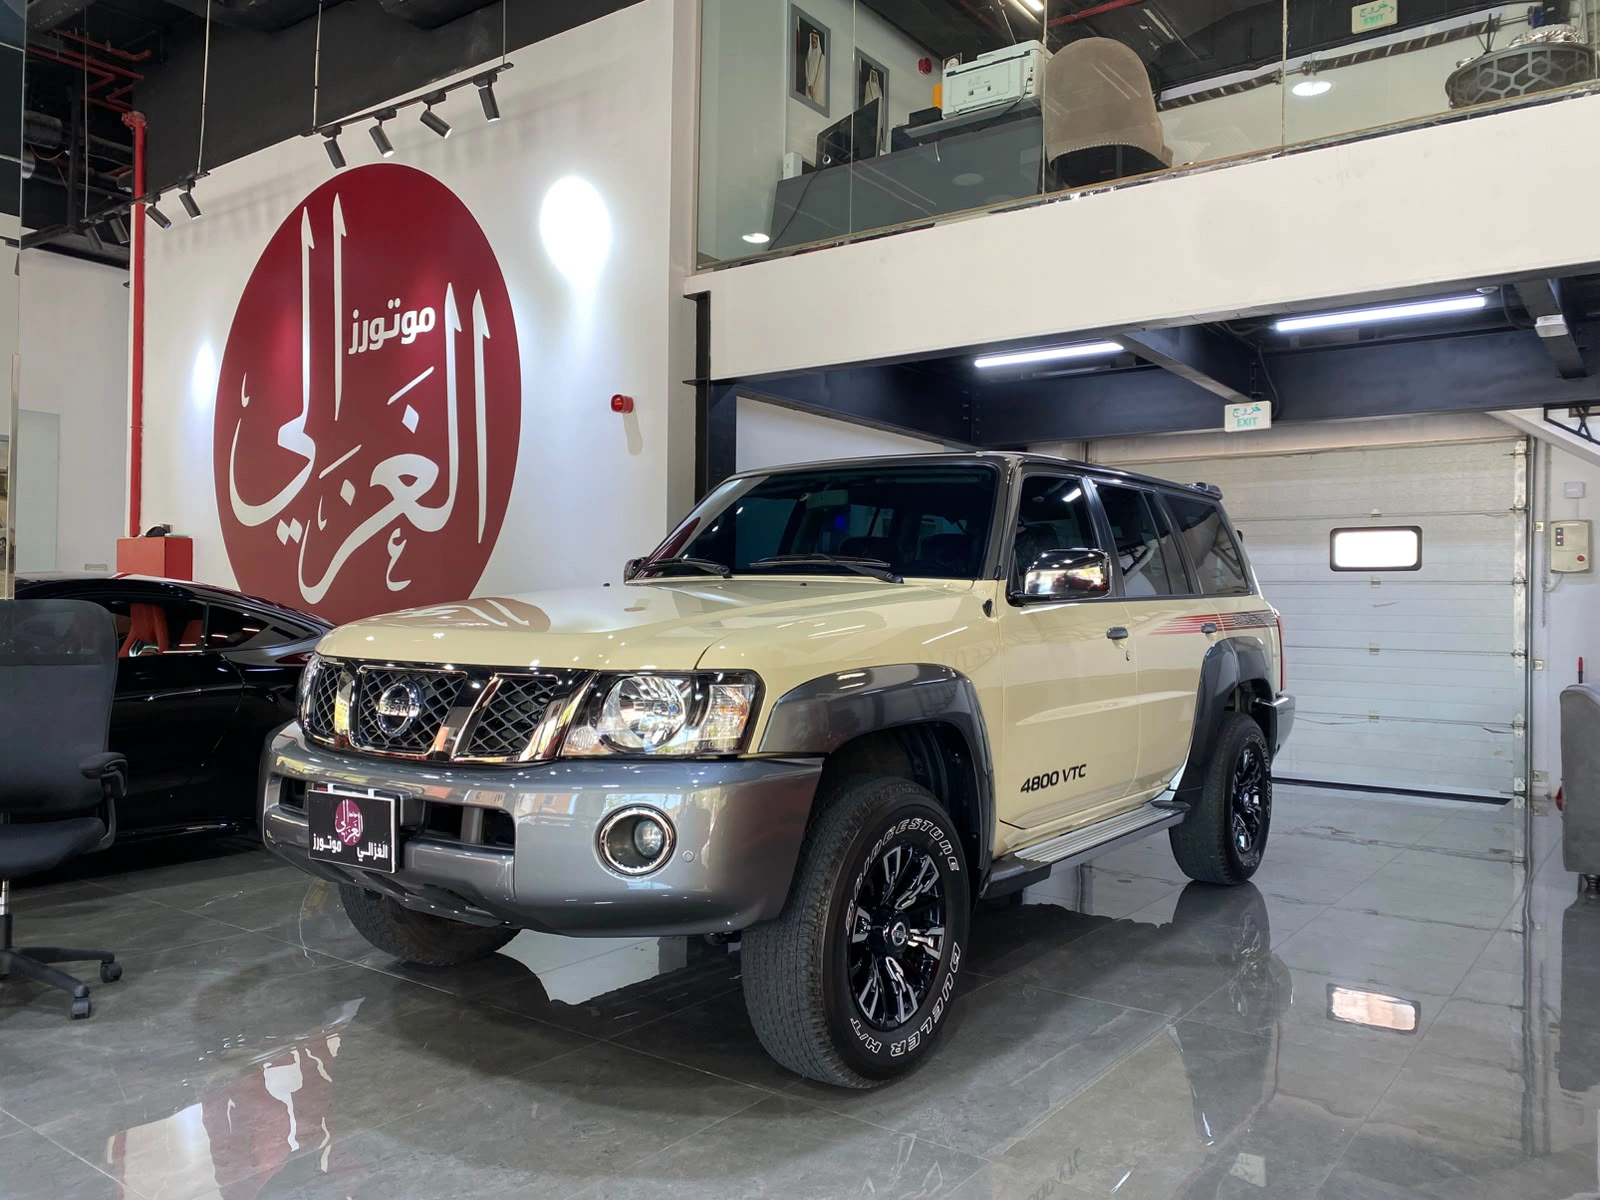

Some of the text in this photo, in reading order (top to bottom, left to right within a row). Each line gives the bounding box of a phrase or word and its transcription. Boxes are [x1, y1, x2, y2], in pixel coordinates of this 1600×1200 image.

[348, 297, 436, 355] موتورز
[1232, 404, 1262, 418] خروج
[1236, 417, 1258, 428] EXIT
[1020, 763, 1087, 793] 4800 VTC
[312, 832, 388, 862] الغزالي موتورز
[845, 817, 960, 936] BRIDGESTONE
[849, 941, 961, 1057] DUELER H/T
